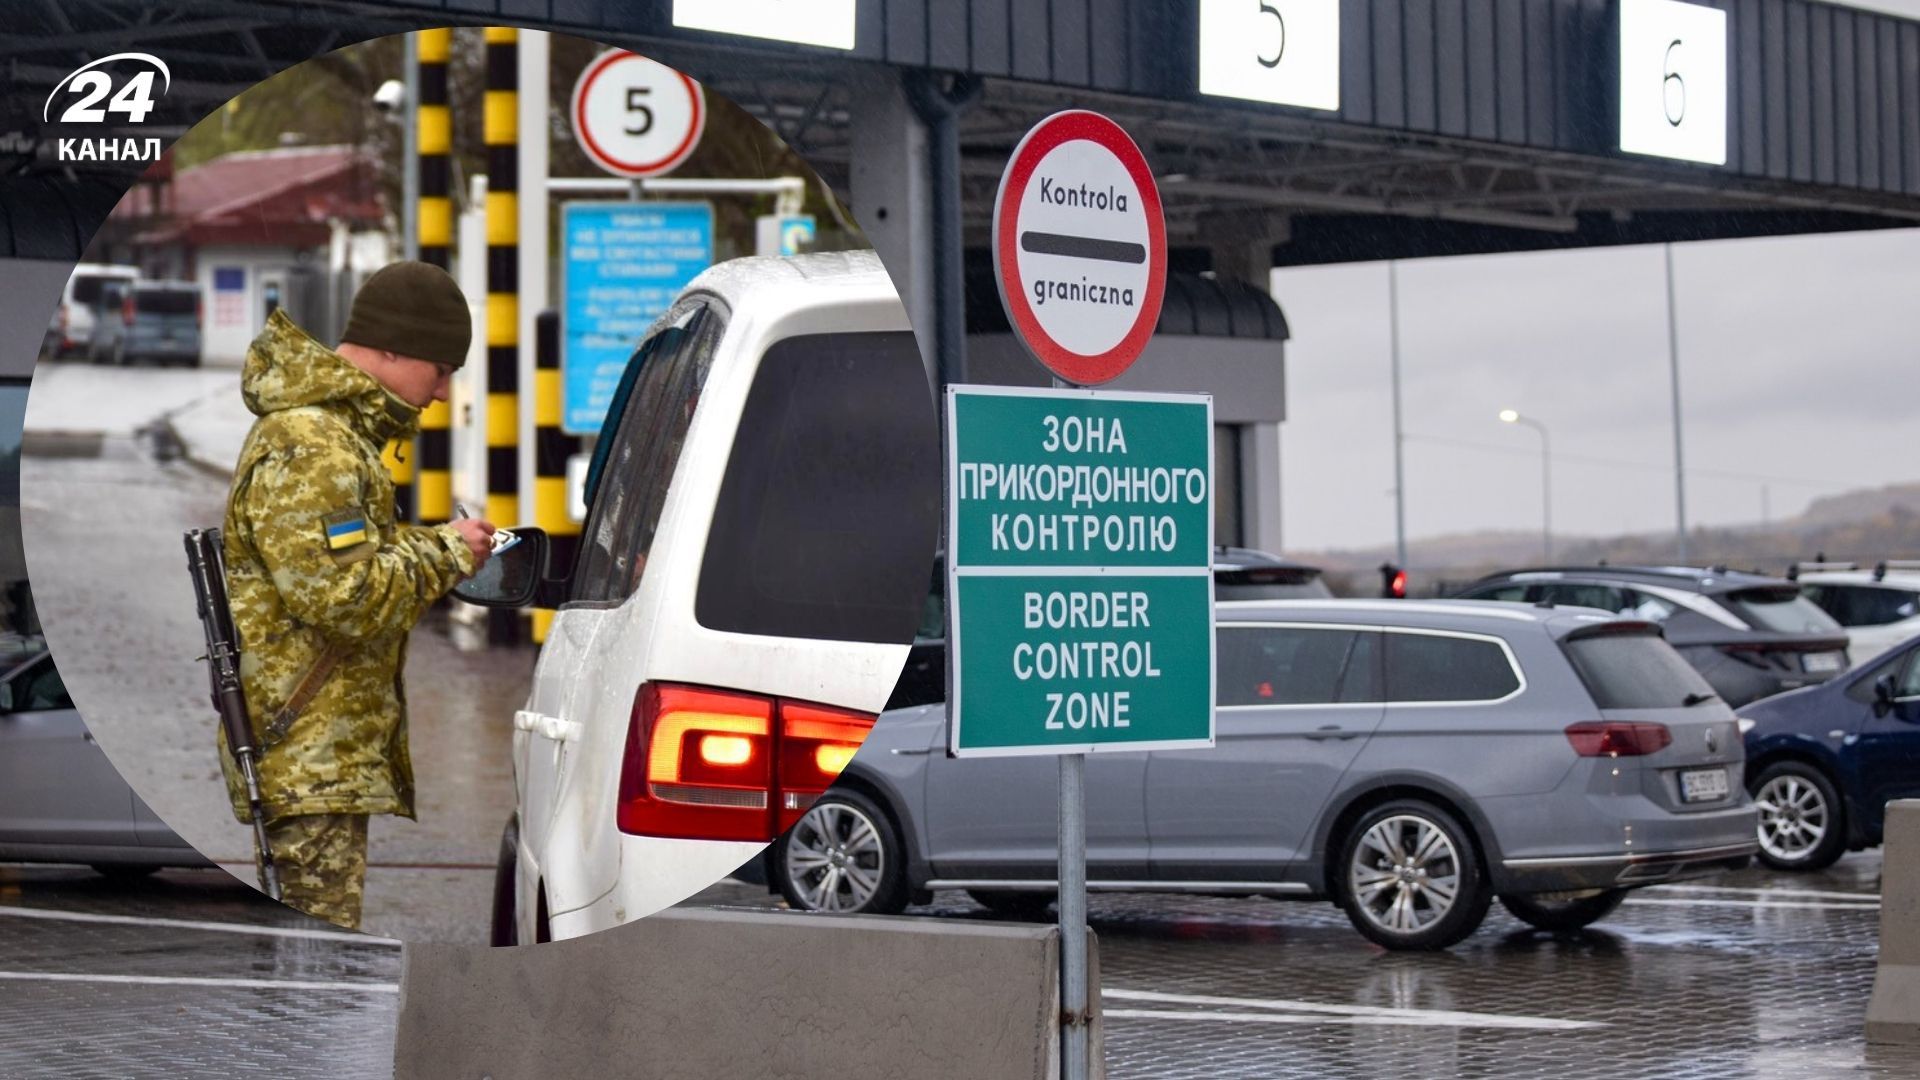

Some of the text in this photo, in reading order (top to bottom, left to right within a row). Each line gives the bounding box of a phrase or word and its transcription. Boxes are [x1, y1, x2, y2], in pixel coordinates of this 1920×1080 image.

[1257, 0, 1285, 69] 5
[1663, 39, 1685, 127] 6
[624, 87, 654, 136] 5
[1040, 177, 1128, 213] Kontrola
[1034, 276, 1134, 306] graniczna
[1042, 415, 1128, 454] ЗОНА
[959, 462, 1206, 508] ПРИКОРДОННОГО
[991, 513, 1178, 552] КОНТРОЛЮ
[1024, 591, 1151, 629] BORDER
[1013, 641, 1161, 680] CONTROL
[1045, 691, 1131, 730] ZONE
